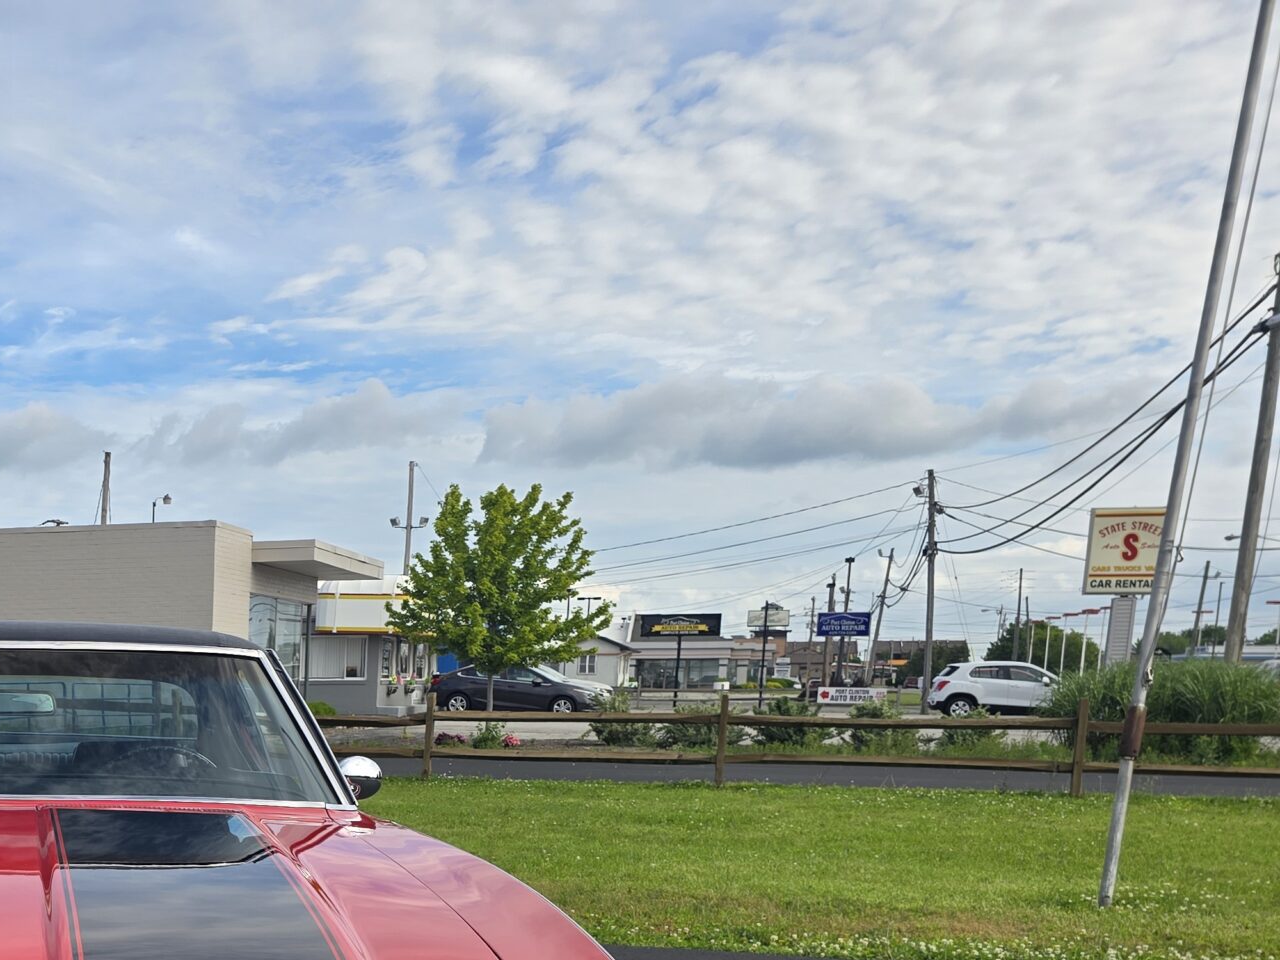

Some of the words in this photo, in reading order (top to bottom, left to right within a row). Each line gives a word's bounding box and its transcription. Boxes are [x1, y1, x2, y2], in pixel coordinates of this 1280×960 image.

[1098, 521, 1127, 538] STATE
[1121, 533, 1139, 562] S
[1090, 579, 1112, 589] CAR
